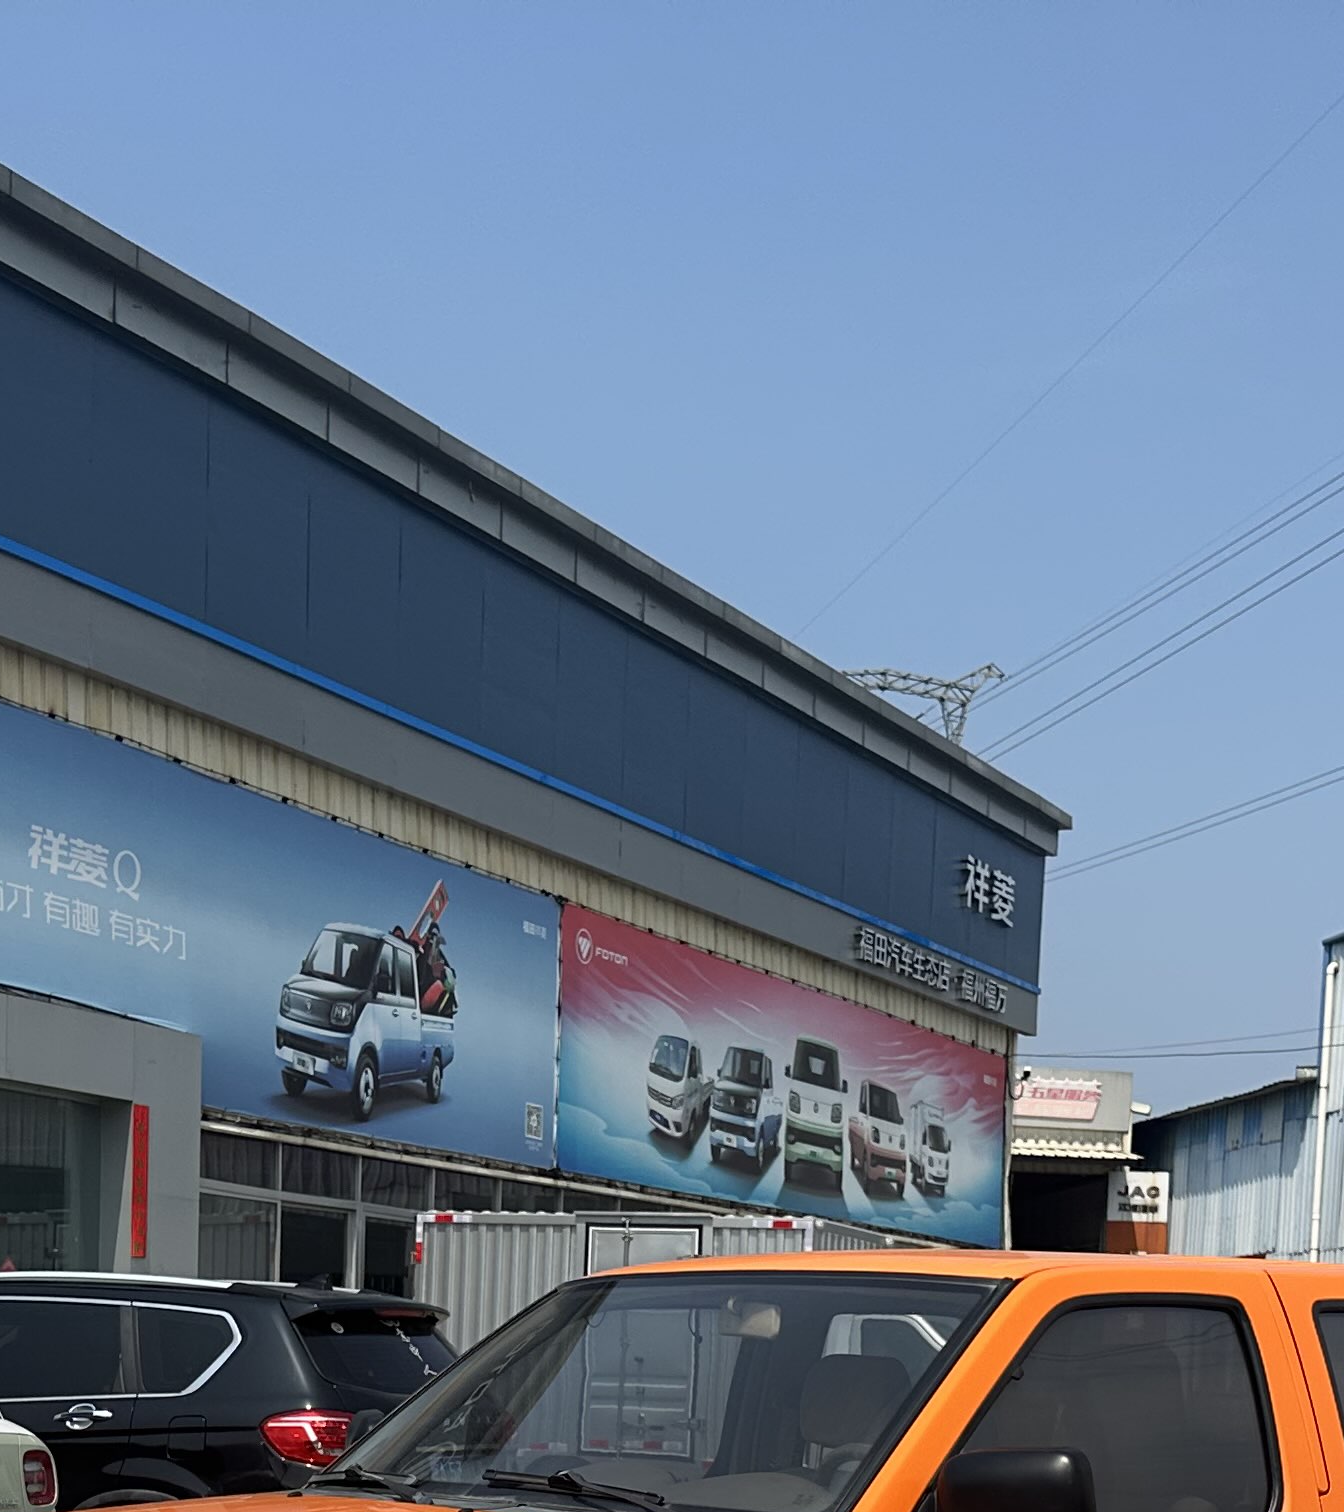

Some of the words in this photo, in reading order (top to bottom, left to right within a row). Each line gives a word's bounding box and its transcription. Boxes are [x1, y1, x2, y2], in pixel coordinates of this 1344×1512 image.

[27, 823, 143, 902] 祥菱Q
[962, 853, 1017, 929] 祥菱
[108, 908, 188, 961] 有实力
[595, 946, 629, 967] FOTON
